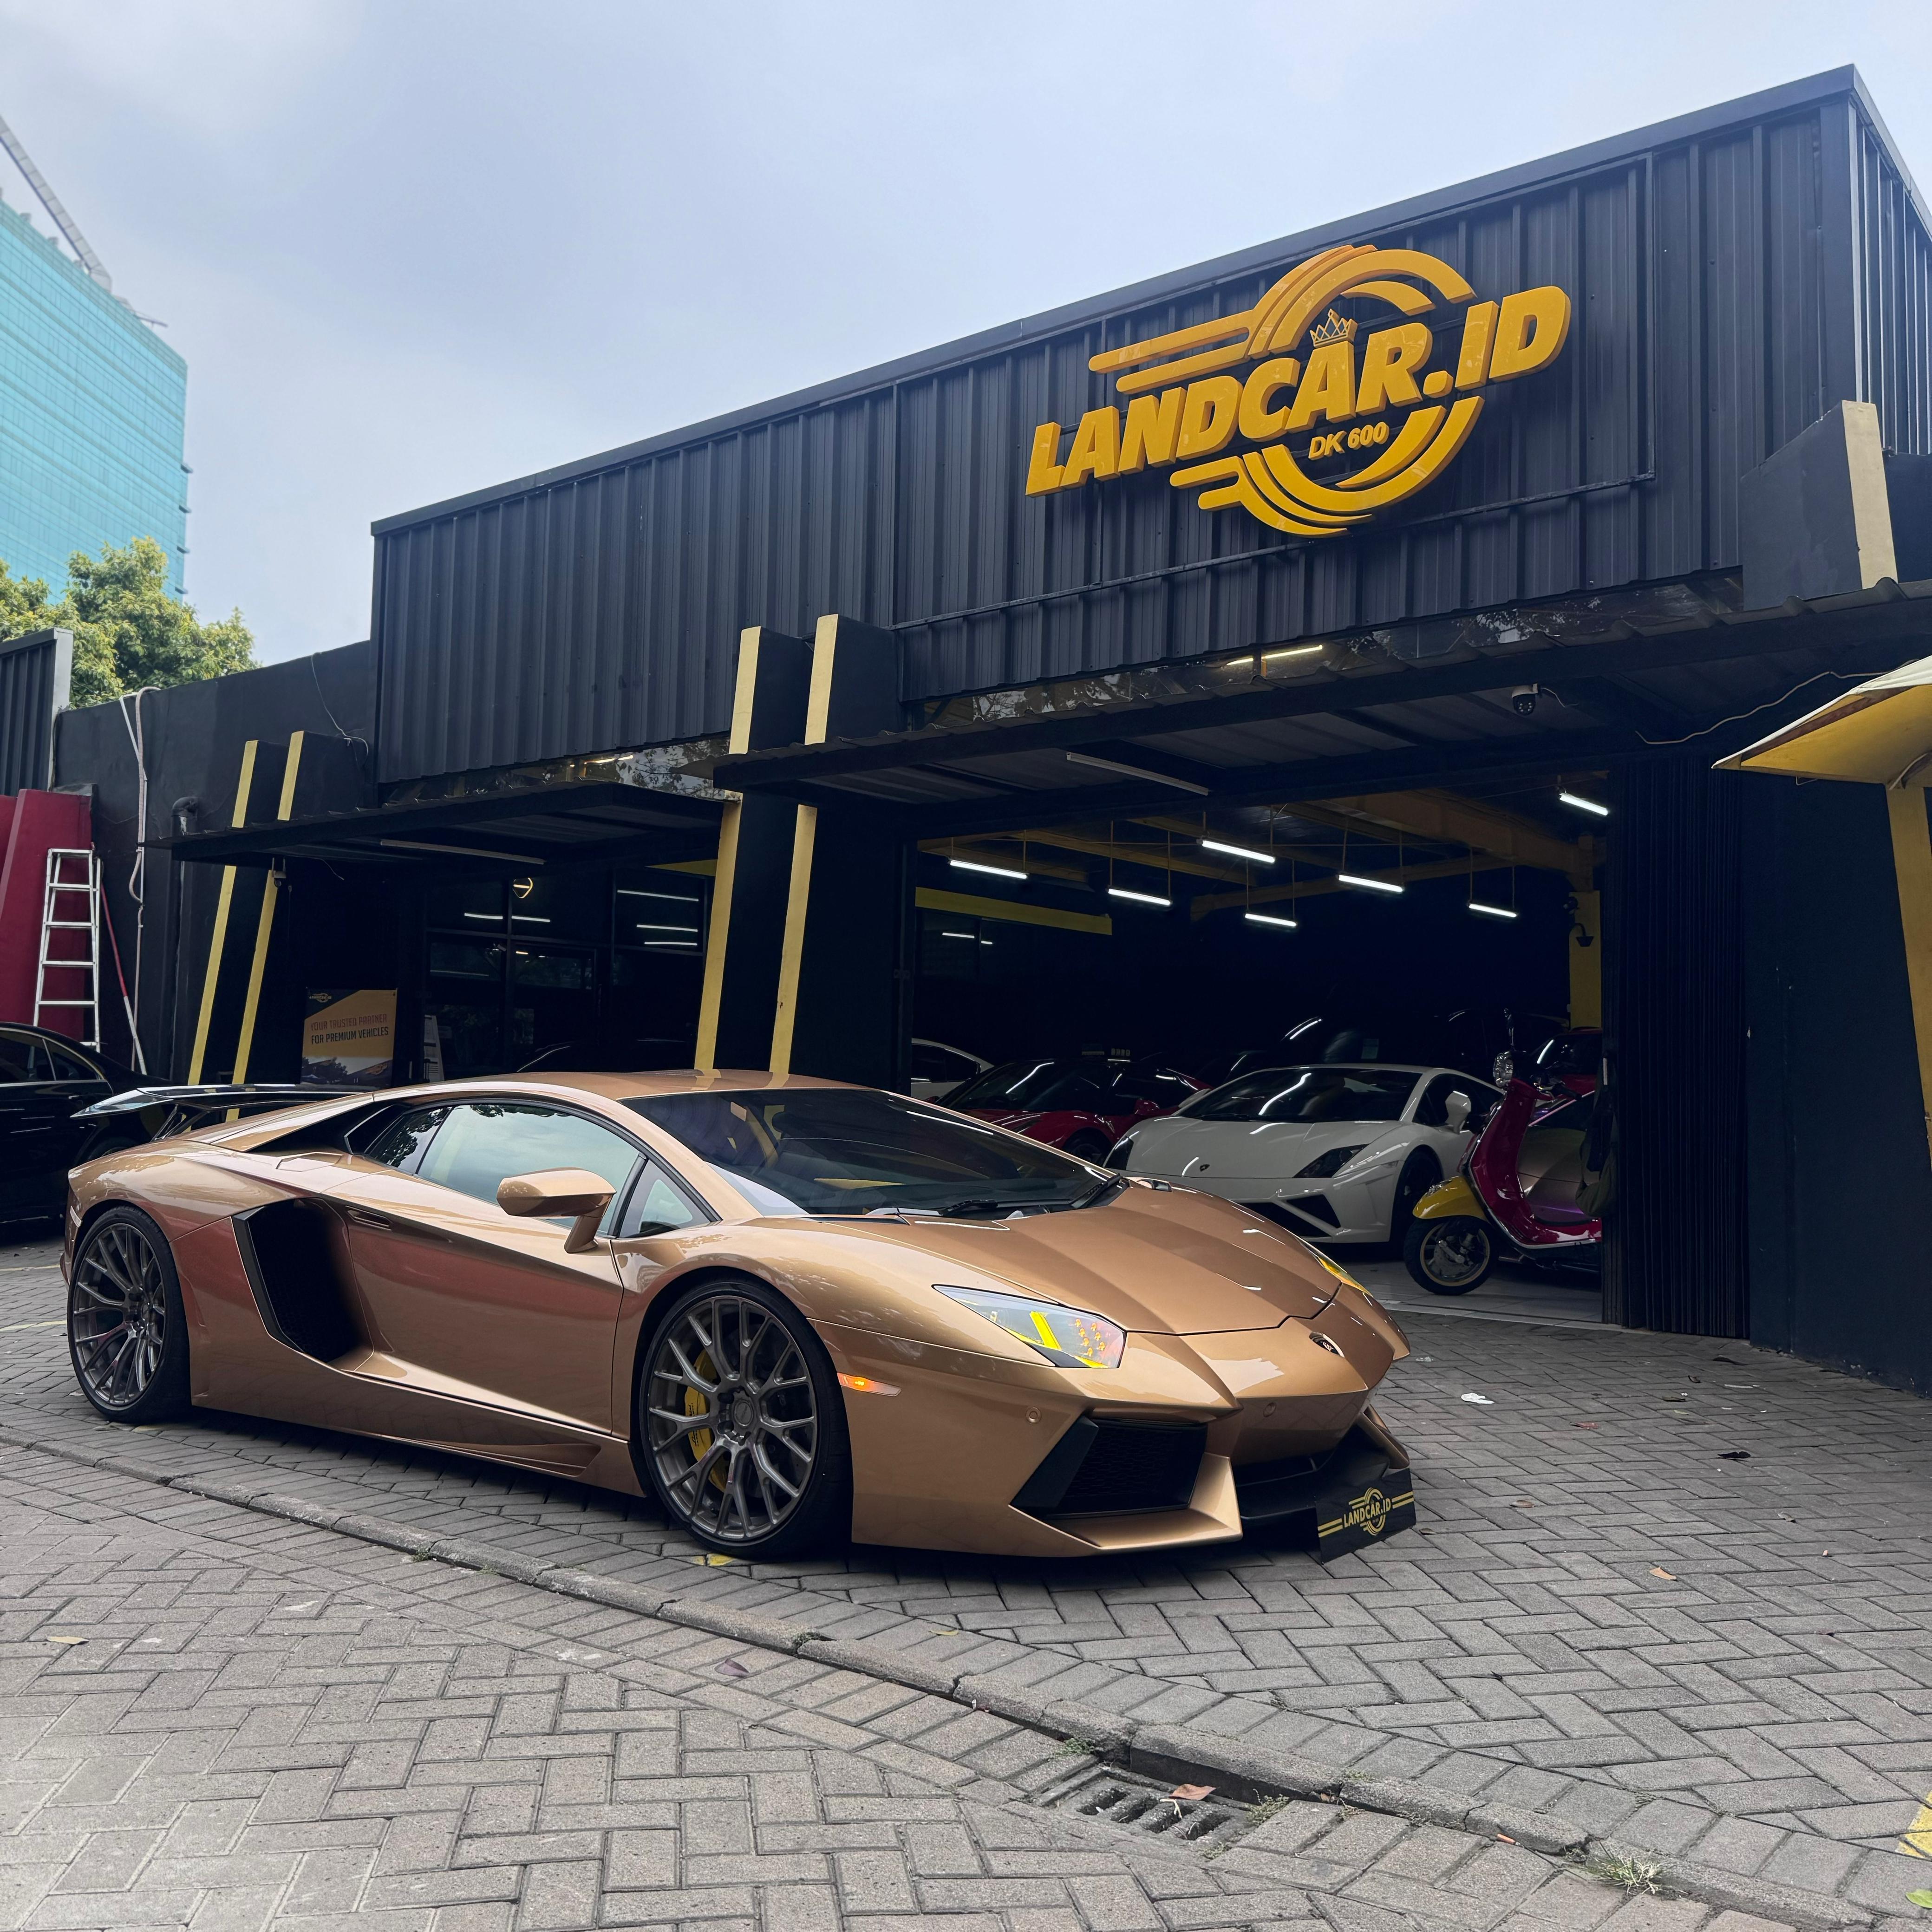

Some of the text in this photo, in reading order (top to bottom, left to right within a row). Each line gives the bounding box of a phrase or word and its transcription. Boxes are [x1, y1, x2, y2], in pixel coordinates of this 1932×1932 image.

[1025, 286, 1571, 496] LANDCAR.ID
[1308, 422, 1390, 460] DK 600
[311, 1013, 387, 1031] YOUR TRUSTED PARTNER
[312, 1026, 389, 1044] FOR PREMIUM VEHICLES
[1344, 1498, 1391, 1528] LANDCAR.ID
